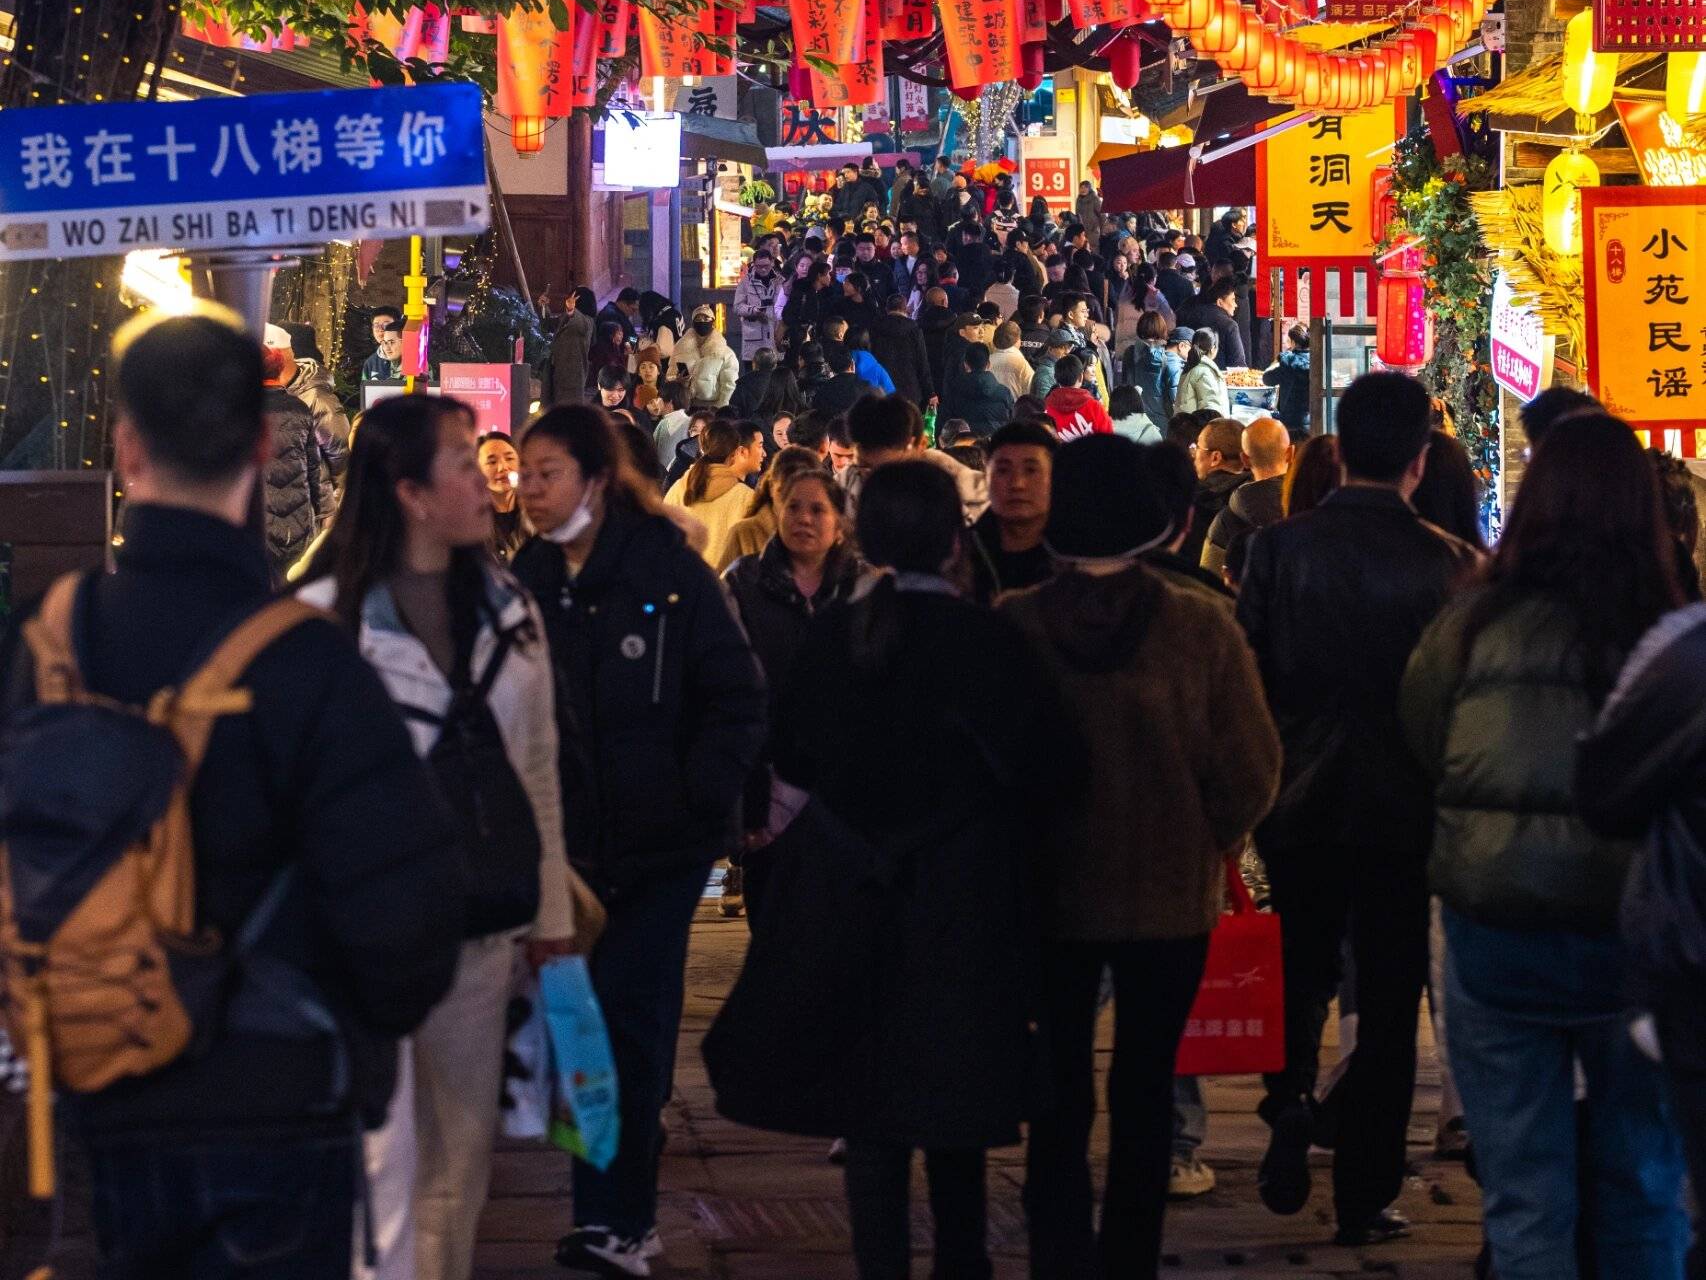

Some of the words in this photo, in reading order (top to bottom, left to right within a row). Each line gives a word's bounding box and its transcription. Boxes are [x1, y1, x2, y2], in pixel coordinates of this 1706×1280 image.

[20, 111, 447, 191] 我在十八梯等你
[1031, 172, 1065, 191] 9.9
[63, 220, 106, 247] WO
[119, 216, 159, 242] ZAI
[173, 213, 213, 240] SHI
[229, 210, 260, 237] BA
[272, 207, 294, 234] TI
[310, 202, 376, 232] DENG
[389, 200, 416, 229] NI
[1610, 245, 1623, 276] 十八梯
[1642, 228, 1693, 398] 小苑民谣
